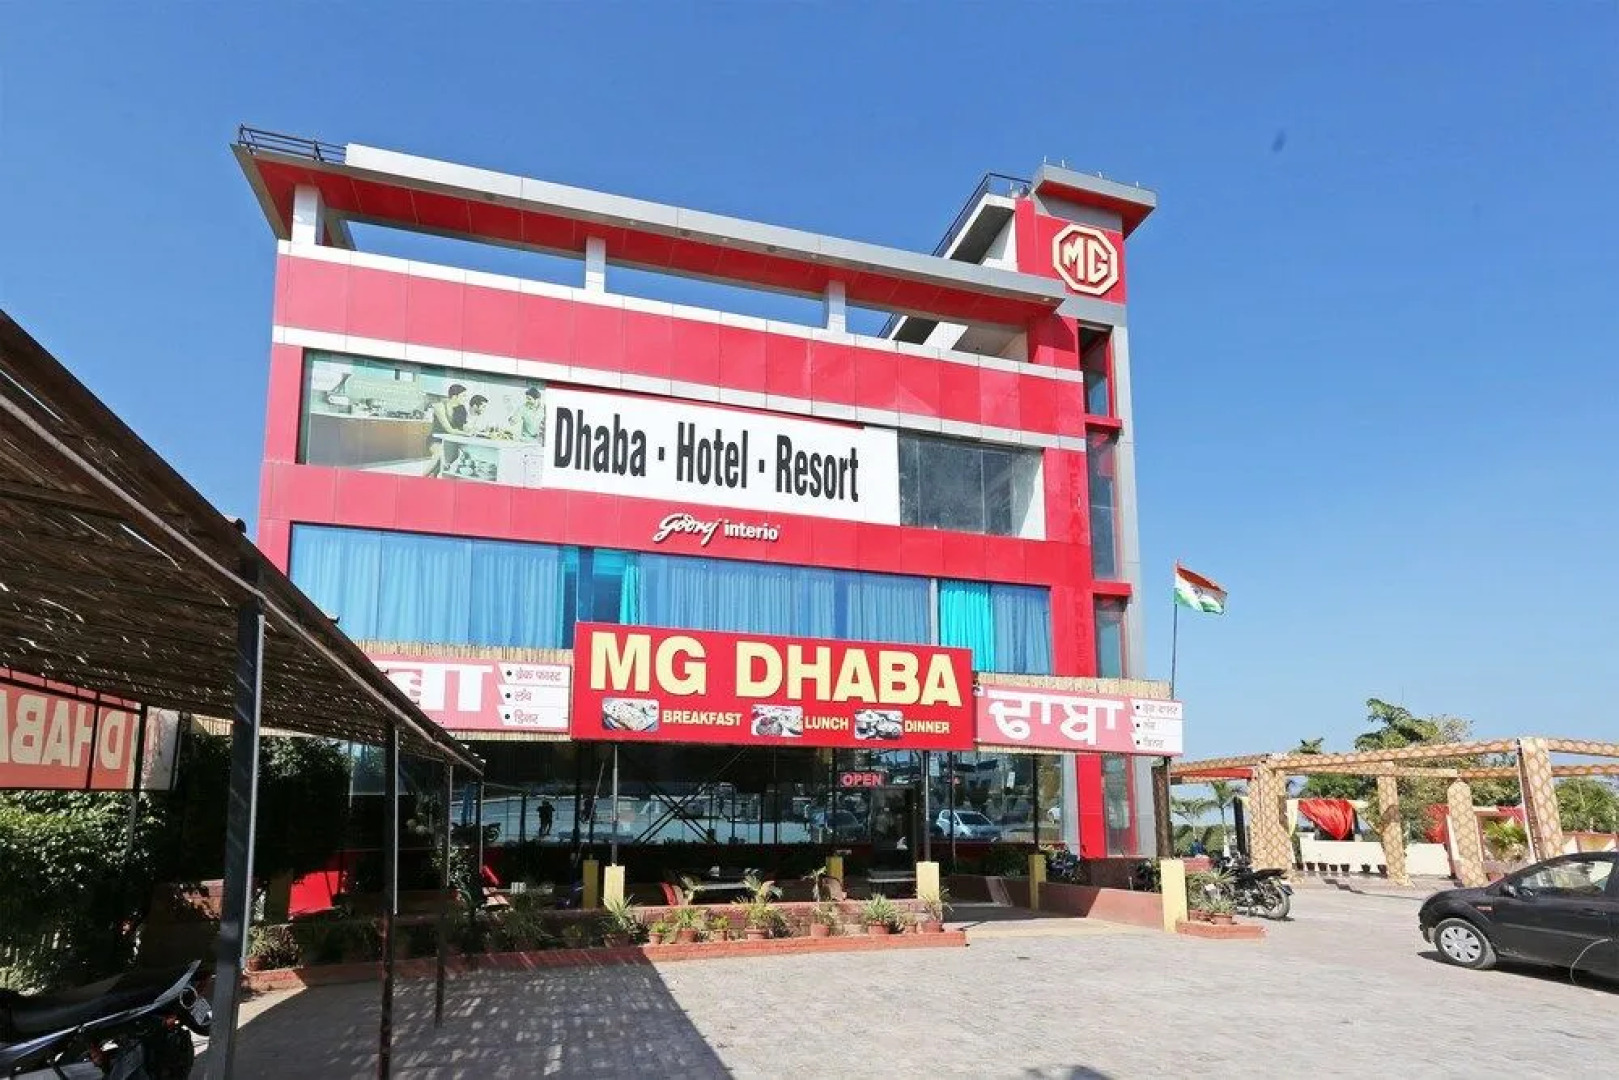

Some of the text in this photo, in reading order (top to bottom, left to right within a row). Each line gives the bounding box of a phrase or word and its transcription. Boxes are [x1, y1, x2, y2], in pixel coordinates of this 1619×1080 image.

[1062, 237, 1108, 283] MG
[554, 407, 859, 502] Dhaba Hotel Resort
[724, 519, 778, 541] interio
[590, 631, 962, 707] MG DHABA
[662, 710, 950, 734] BREAKFAST LUNCH DINNER
[987, 689, 1125, 745] ਢਾਬਾ
[843, 773, 882, 786] OPEN
